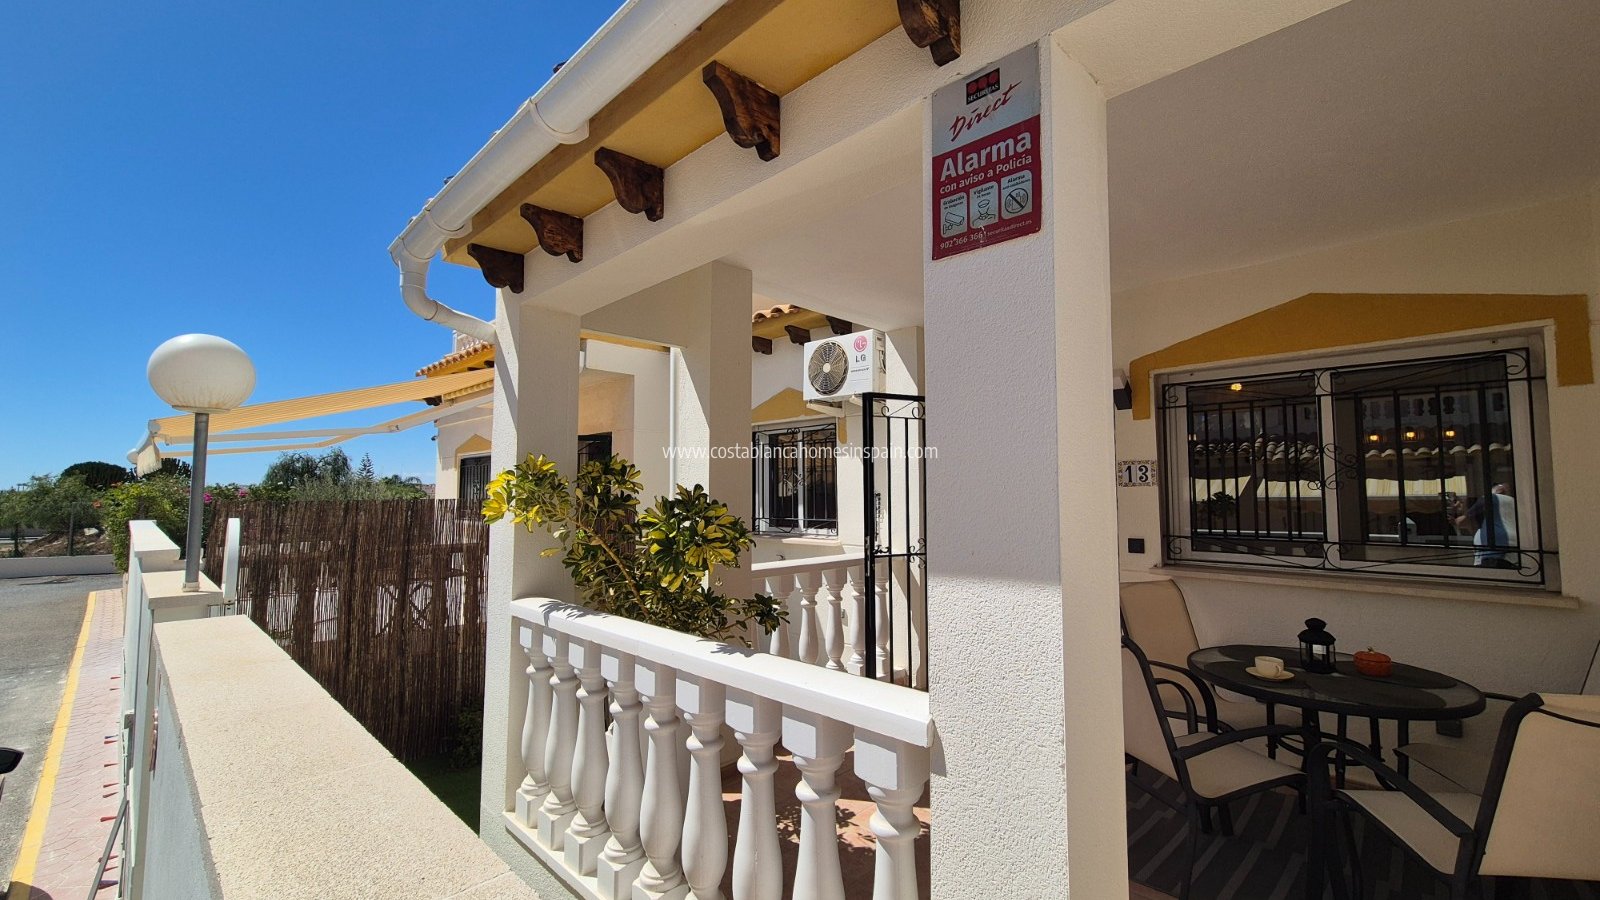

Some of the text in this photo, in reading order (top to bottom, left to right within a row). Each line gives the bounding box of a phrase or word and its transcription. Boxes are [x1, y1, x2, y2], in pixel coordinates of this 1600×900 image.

[949, 81, 1022, 142] Direct
[940, 132, 1031, 182] Alarma
[940, 154, 1033, 194] con aviso a Policía
[940, 231, 983, 250] 902 366 366
[855, 354, 867, 363] LG
[1124, 464, 1149, 483] 13
